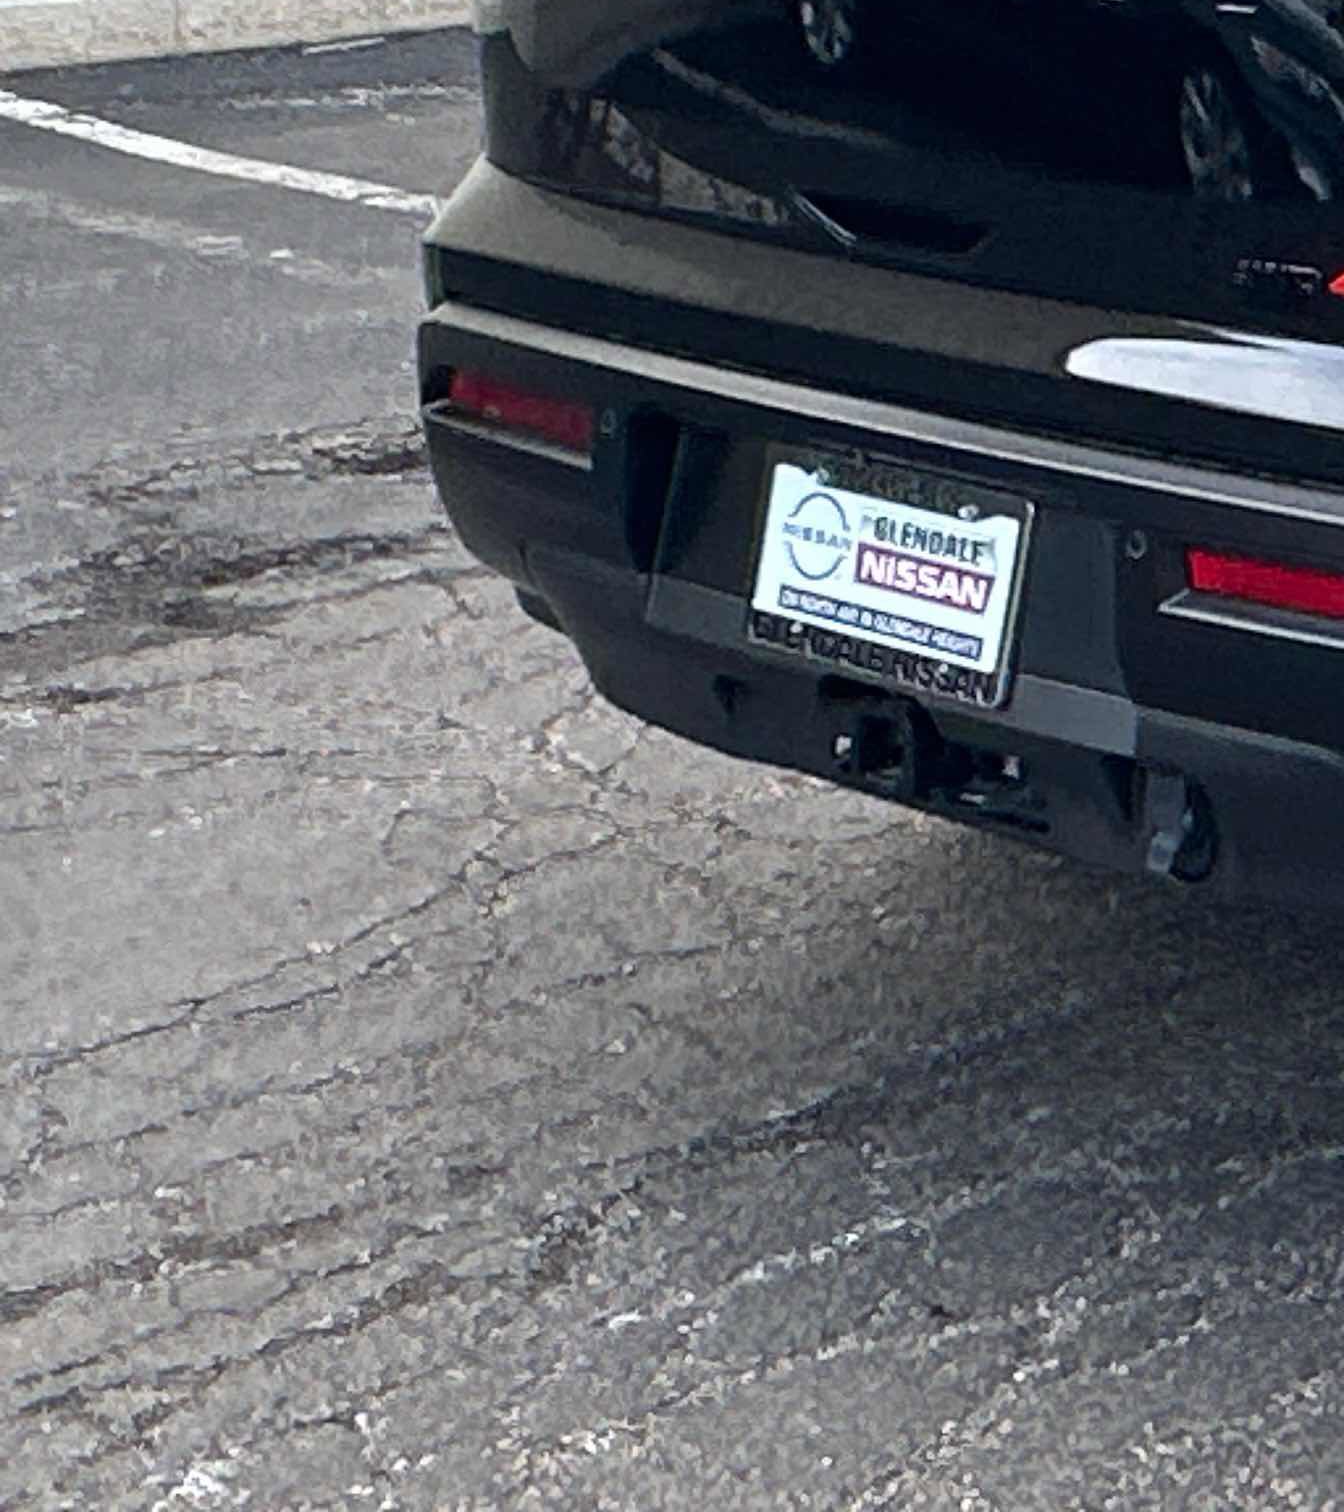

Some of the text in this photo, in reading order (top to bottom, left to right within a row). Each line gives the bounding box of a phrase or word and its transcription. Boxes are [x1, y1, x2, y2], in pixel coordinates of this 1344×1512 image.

[783, 522, 852, 552] NISSAN
[873, 515, 986, 567] GLENDALE
[859, 549, 989, 610] NISSAN
